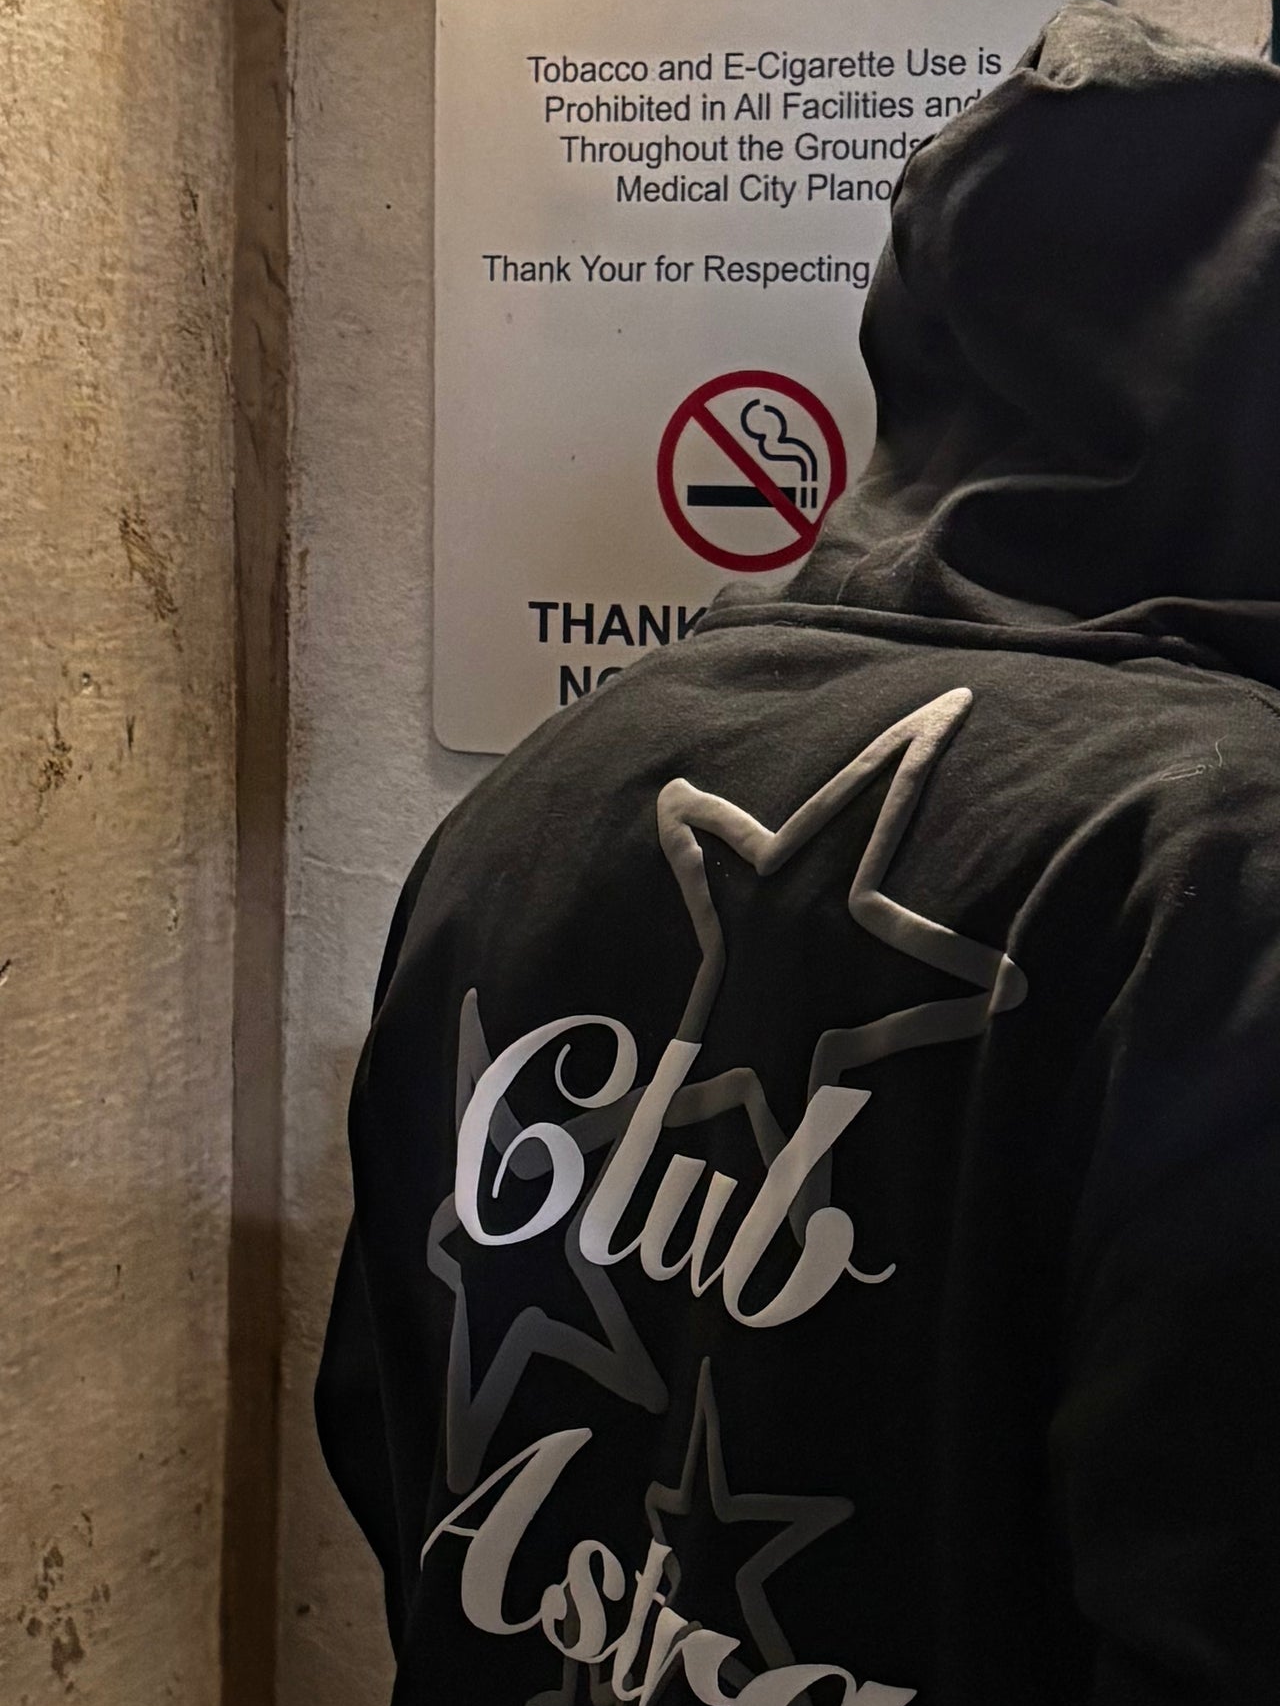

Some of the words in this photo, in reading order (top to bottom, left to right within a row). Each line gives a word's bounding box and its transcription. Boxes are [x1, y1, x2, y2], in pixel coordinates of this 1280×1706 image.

[526, 55, 649, 83] Tobacco
[658, 53, 712, 81] and
[724, 50, 895, 87] E-Cigarette
[907, 48, 966, 77] Use
[978, 47, 1002, 76] is
[545, 94, 691, 123] Prohibited
[702, 93, 726, 122] in
[734, 92, 771, 121] All
[783, 91, 914, 120] Facilities
[560, 134, 728, 170] Throughout
[737, 134, 784, 161] the
[617, 174, 728, 203] Medical
[740, 173, 797, 209] City
[808, 173, 892, 202] Plano
[482, 254, 571, 284] Thank
[580, 254, 647, 283] Your
[654, 254, 695, 283] for
[704, 254, 871, 289] Respecting
[528, 601, 708, 647] THANK
[455, 1014, 897, 1328] Club
